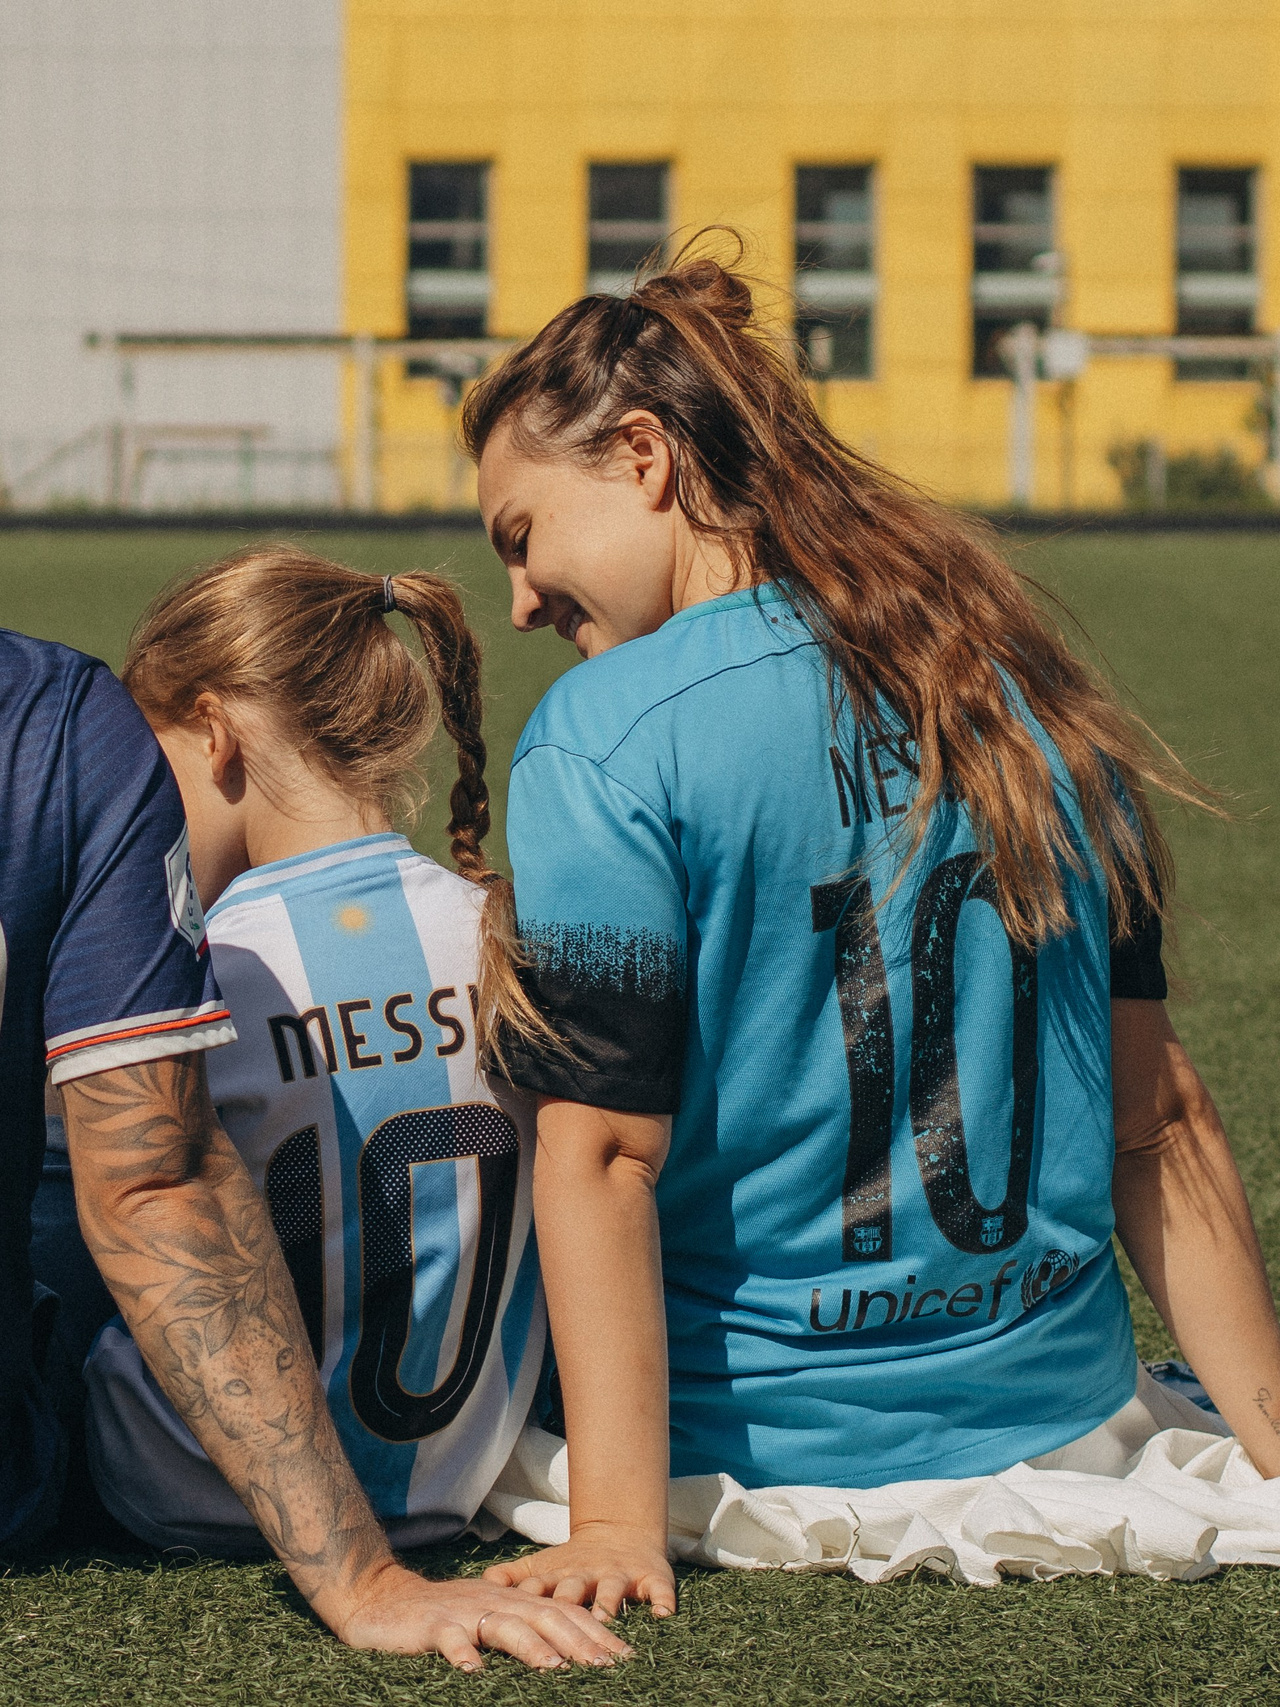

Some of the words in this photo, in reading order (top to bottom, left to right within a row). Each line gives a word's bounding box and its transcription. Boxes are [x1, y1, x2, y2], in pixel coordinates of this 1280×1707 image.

[809, 851, 1039, 1262] 10
[264, 1100, 520, 1443] 10
[809, 1259, 1018, 1332] unicef
